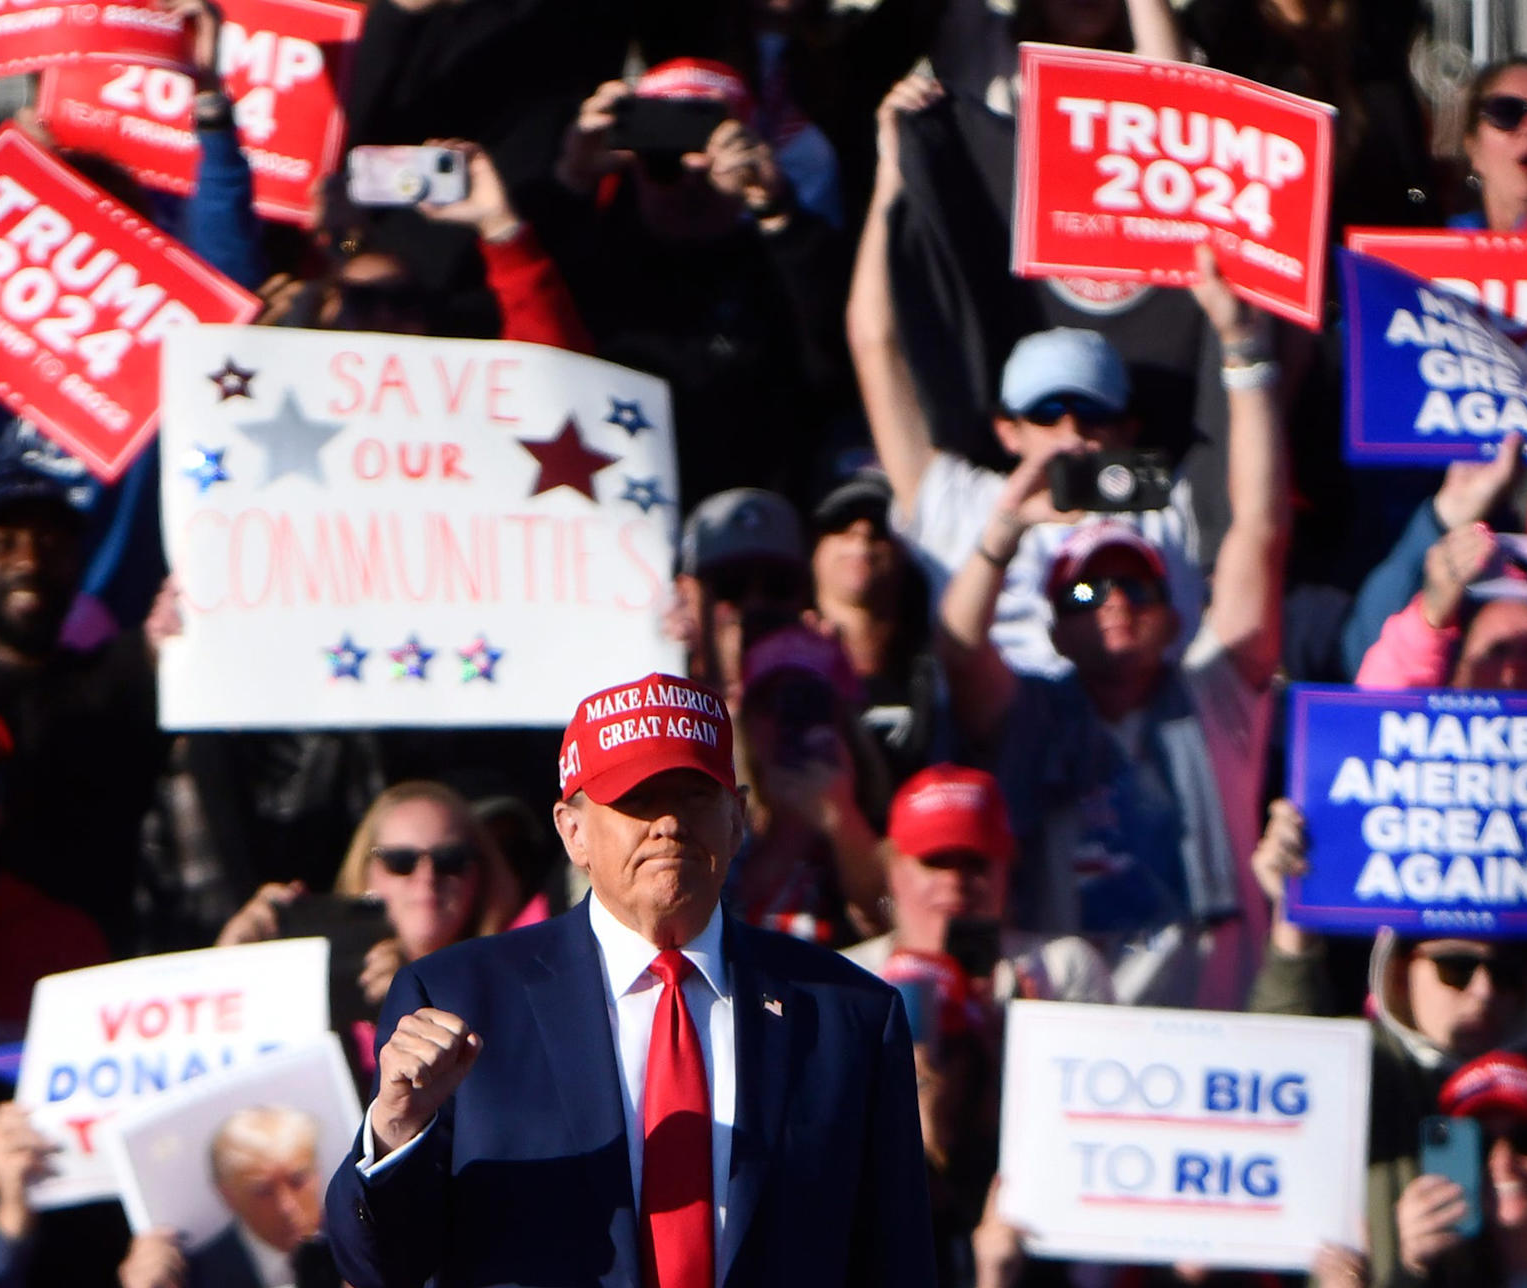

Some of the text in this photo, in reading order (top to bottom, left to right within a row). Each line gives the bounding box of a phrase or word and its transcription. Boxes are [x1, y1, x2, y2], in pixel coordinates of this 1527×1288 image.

[1056, 97, 1306, 190] TRUMP
[1092, 154, 1273, 239] 2024
[329, 350, 524, 424] SAVE
[351, 437, 472, 482] OUR
[174, 507, 664, 615] COMMUNITIES
[586, 684, 724, 723] MAKE AMERICA
[599, 716, 717, 751] GREAT AGAIN
[99, 992, 245, 1043] VOTE
[1052, 1057, 1310, 1116] TOO BIG
[1074, 1141, 1280, 1199] TO RIG
